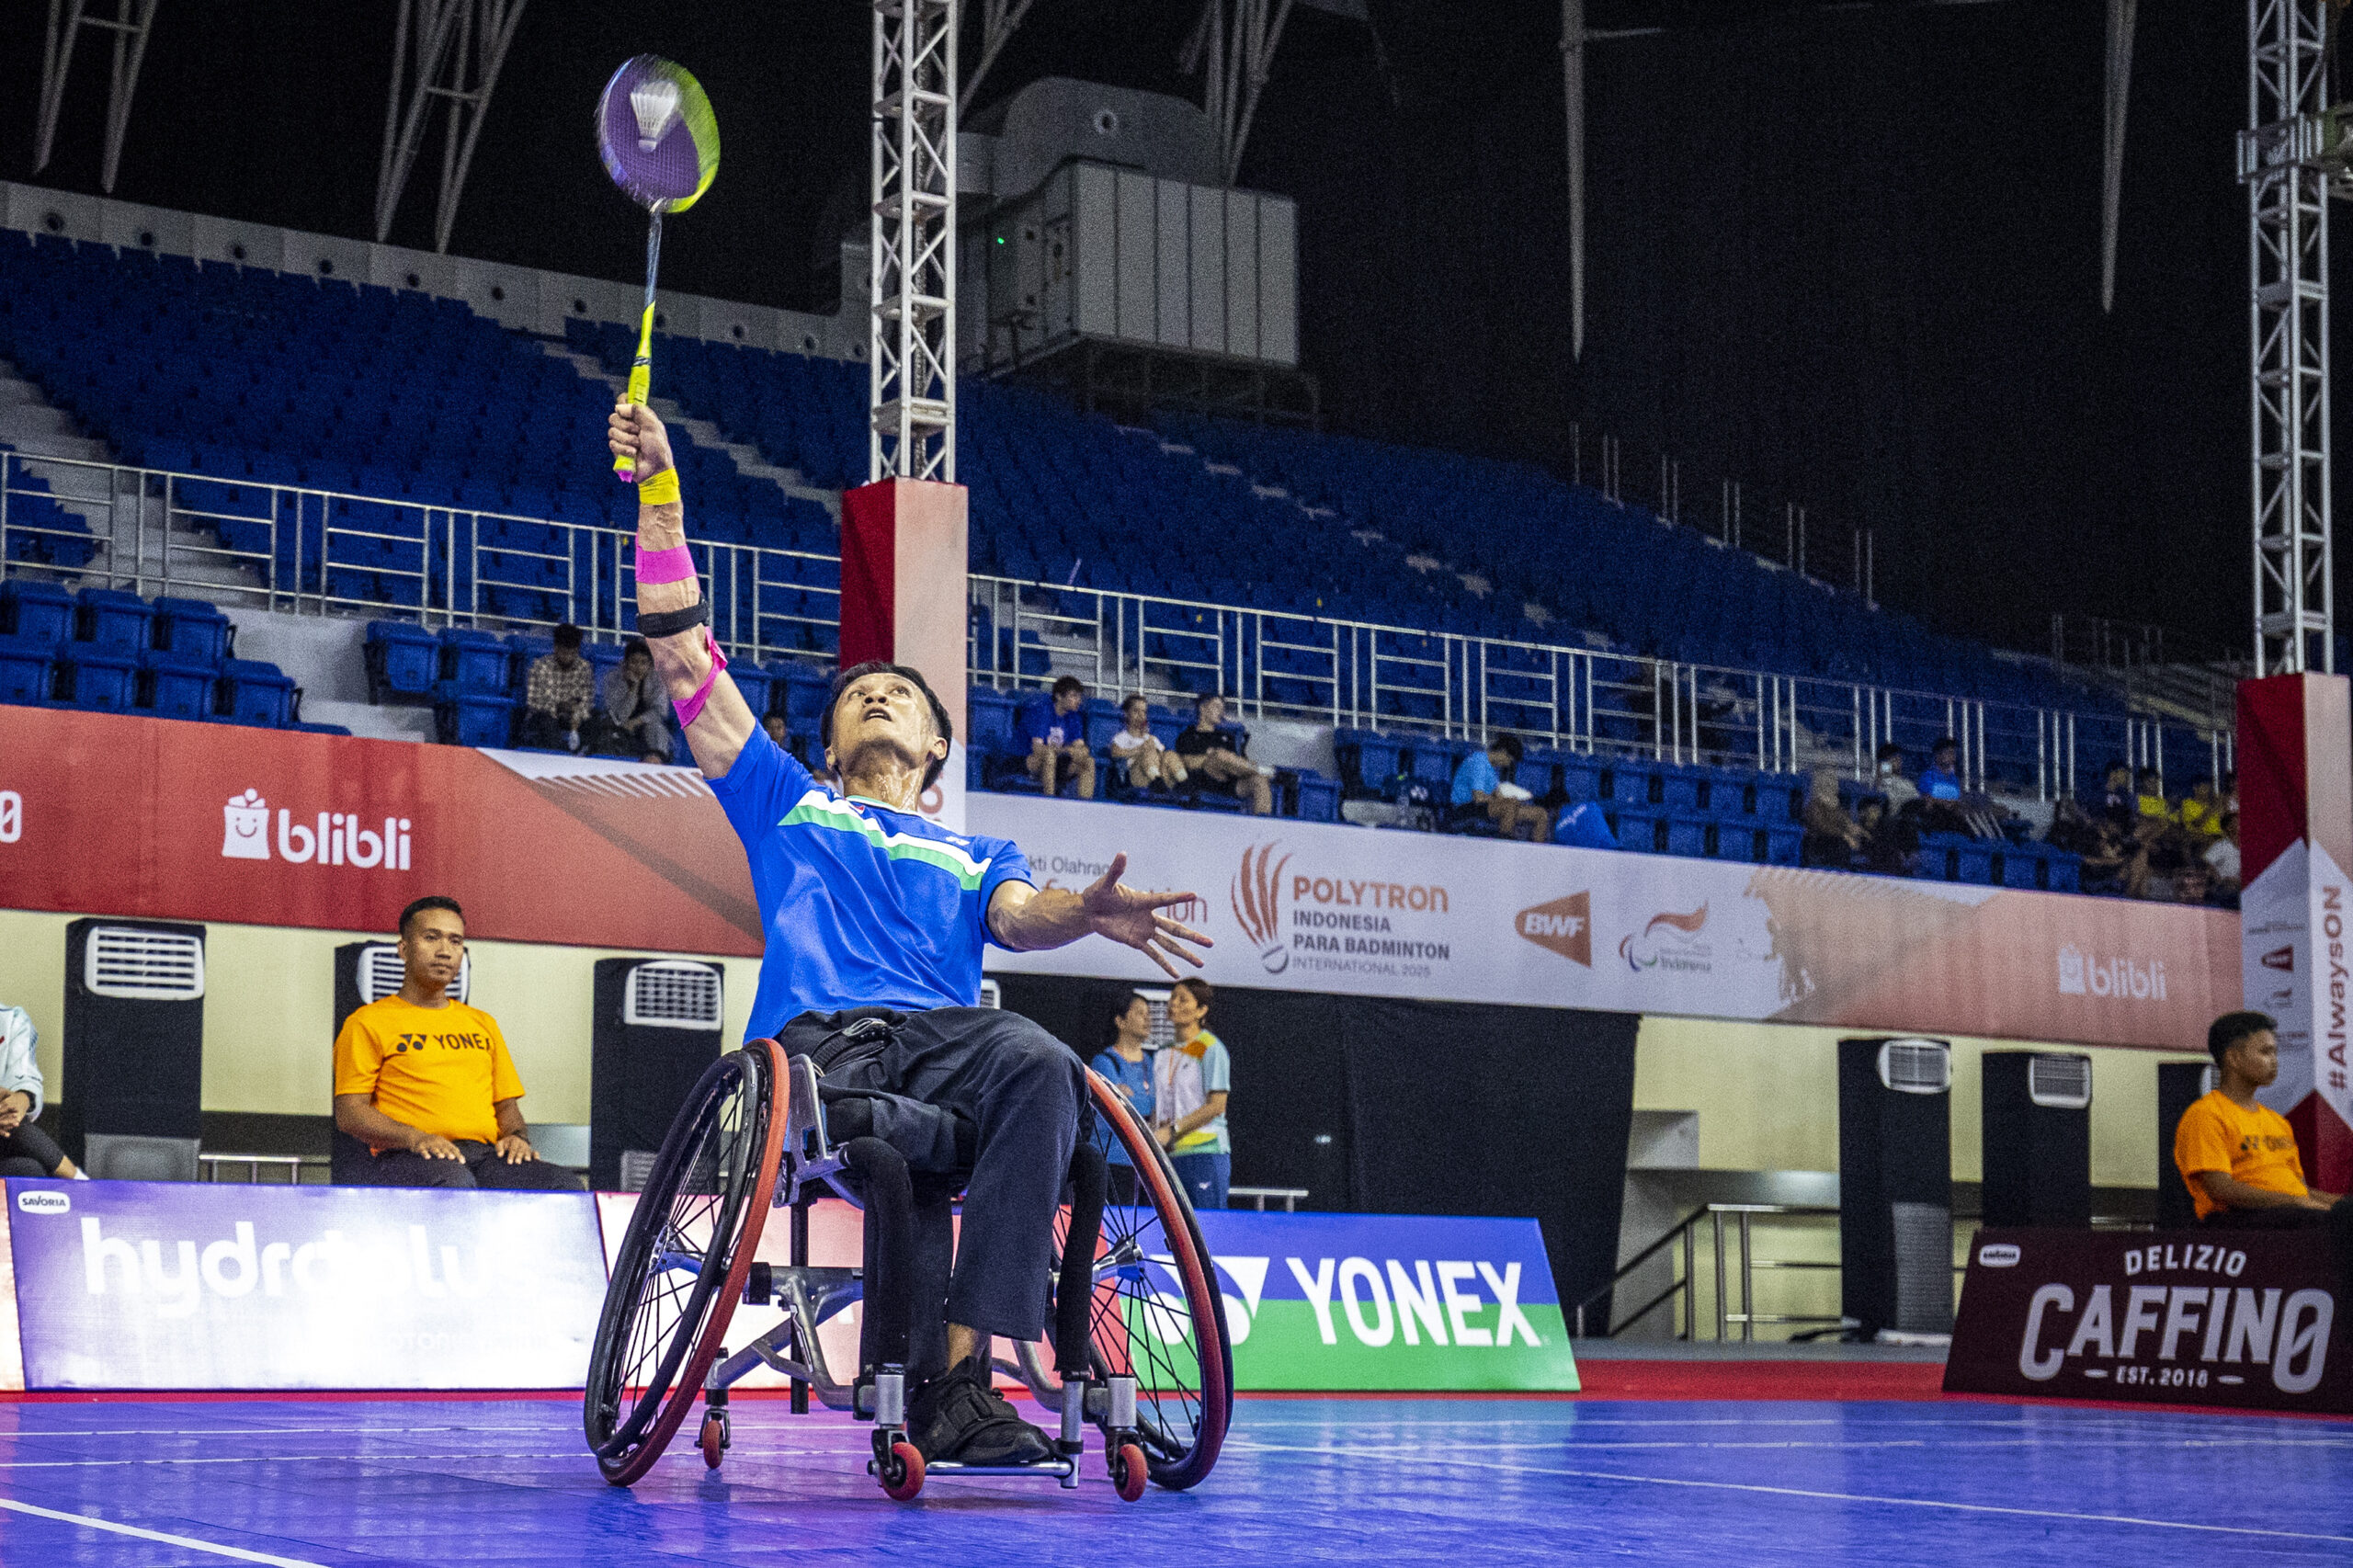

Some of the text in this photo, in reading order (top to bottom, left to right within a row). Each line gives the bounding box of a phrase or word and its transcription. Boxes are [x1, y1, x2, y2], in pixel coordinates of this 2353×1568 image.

[278, 809, 411, 870] blibli
[1029, 856, 1047, 871] kti
[1293, 875, 1449, 913] POLYTRON
[1293, 910, 1391, 933] INDONESIA
[1526, 913, 1585, 938] BWF
[1293, 933, 1450, 961] PARA BADMINTON
[2087, 953, 2167, 1002] blibli
[2322, 885, 2349, 1090] #AlwaysON
[22, 1195, 66, 1206] SAVORIA
[2125, 1244, 2247, 1278] DELIZIO
[1286, 1256, 1541, 1347] YONEX
[2018, 1282, 2335, 1394] CAFFINO
